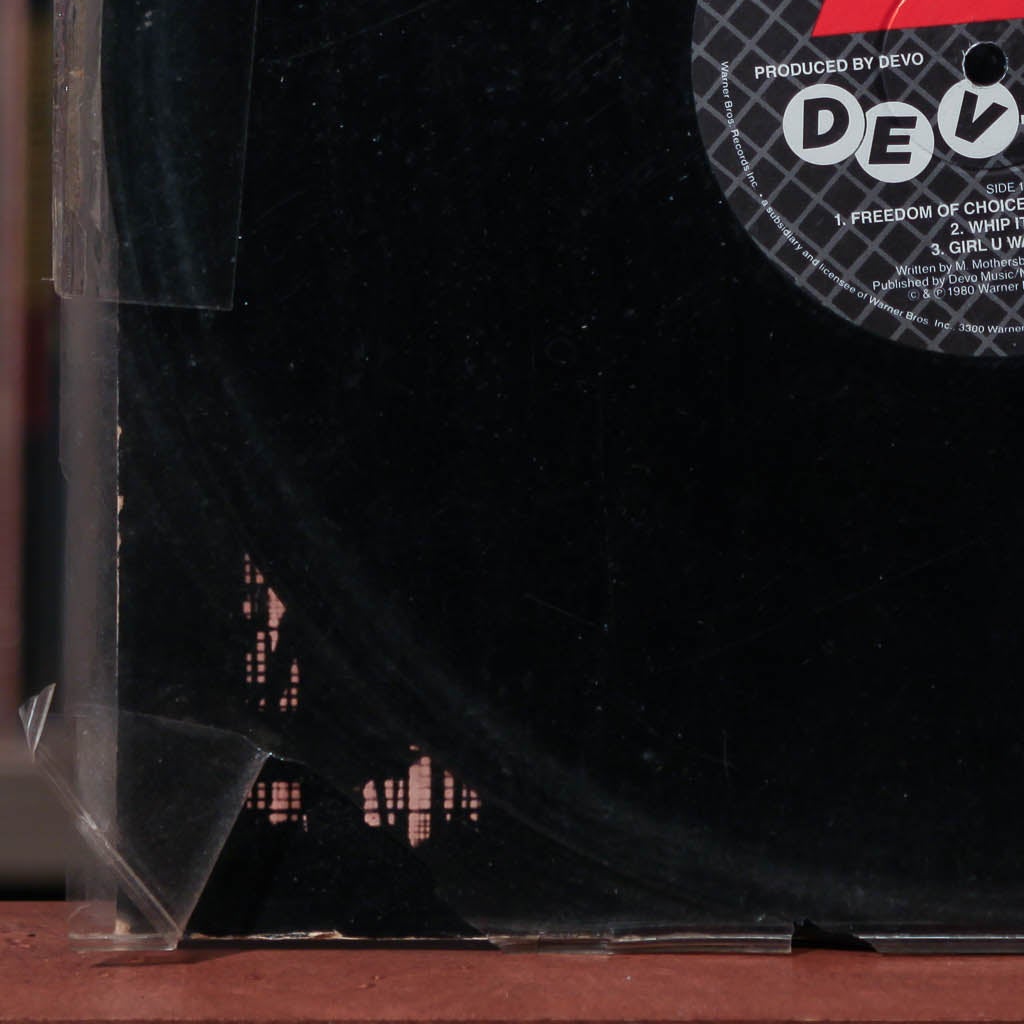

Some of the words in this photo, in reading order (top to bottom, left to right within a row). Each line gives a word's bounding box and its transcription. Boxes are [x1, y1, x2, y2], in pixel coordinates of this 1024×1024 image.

[754, 58, 849, 79] PRODUCED
[852, 56, 874, 71] BY
[878, 52, 924, 69] DEVO
[720, 60, 730, 98] Warner
[730, 128, 750, 172] Records
[761, 199, 769, 207] a
[766, 206, 803, 251] subsidiary
[802, 250, 821, 267] and
[819, 263, 856, 294] licensee
[857, 291, 868, 300] of
[869, 295, 904, 318] Warner
[958, 323, 985, 334] 3300
[987, 325, 1024, 334] Warner
[986, 182, 1016, 195] SIDE
[1018, 181, 1024, 192] 1
[834, 213, 847, 227] 1.
[851, 204, 933, 225] FREEDOM
[937, 202, 960, 218] OF
[950, 222, 964, 236] 2.
[968, 218, 1011, 234] WHIP
[930, 243, 945, 256] 3.
[949, 239, 988, 255] GIRL
[991, 237, 1002, 251] U
[895, 264, 936, 276] Written
[939, 262, 953, 275] by
[872, 277, 929, 291] Published
[932, 275, 946, 288] by
[948, 274, 978, 285] Devo
[922, 289, 931, 299] &
[948, 284, 975, 297] 1980
[978, 282, 1020, 295] Warner
